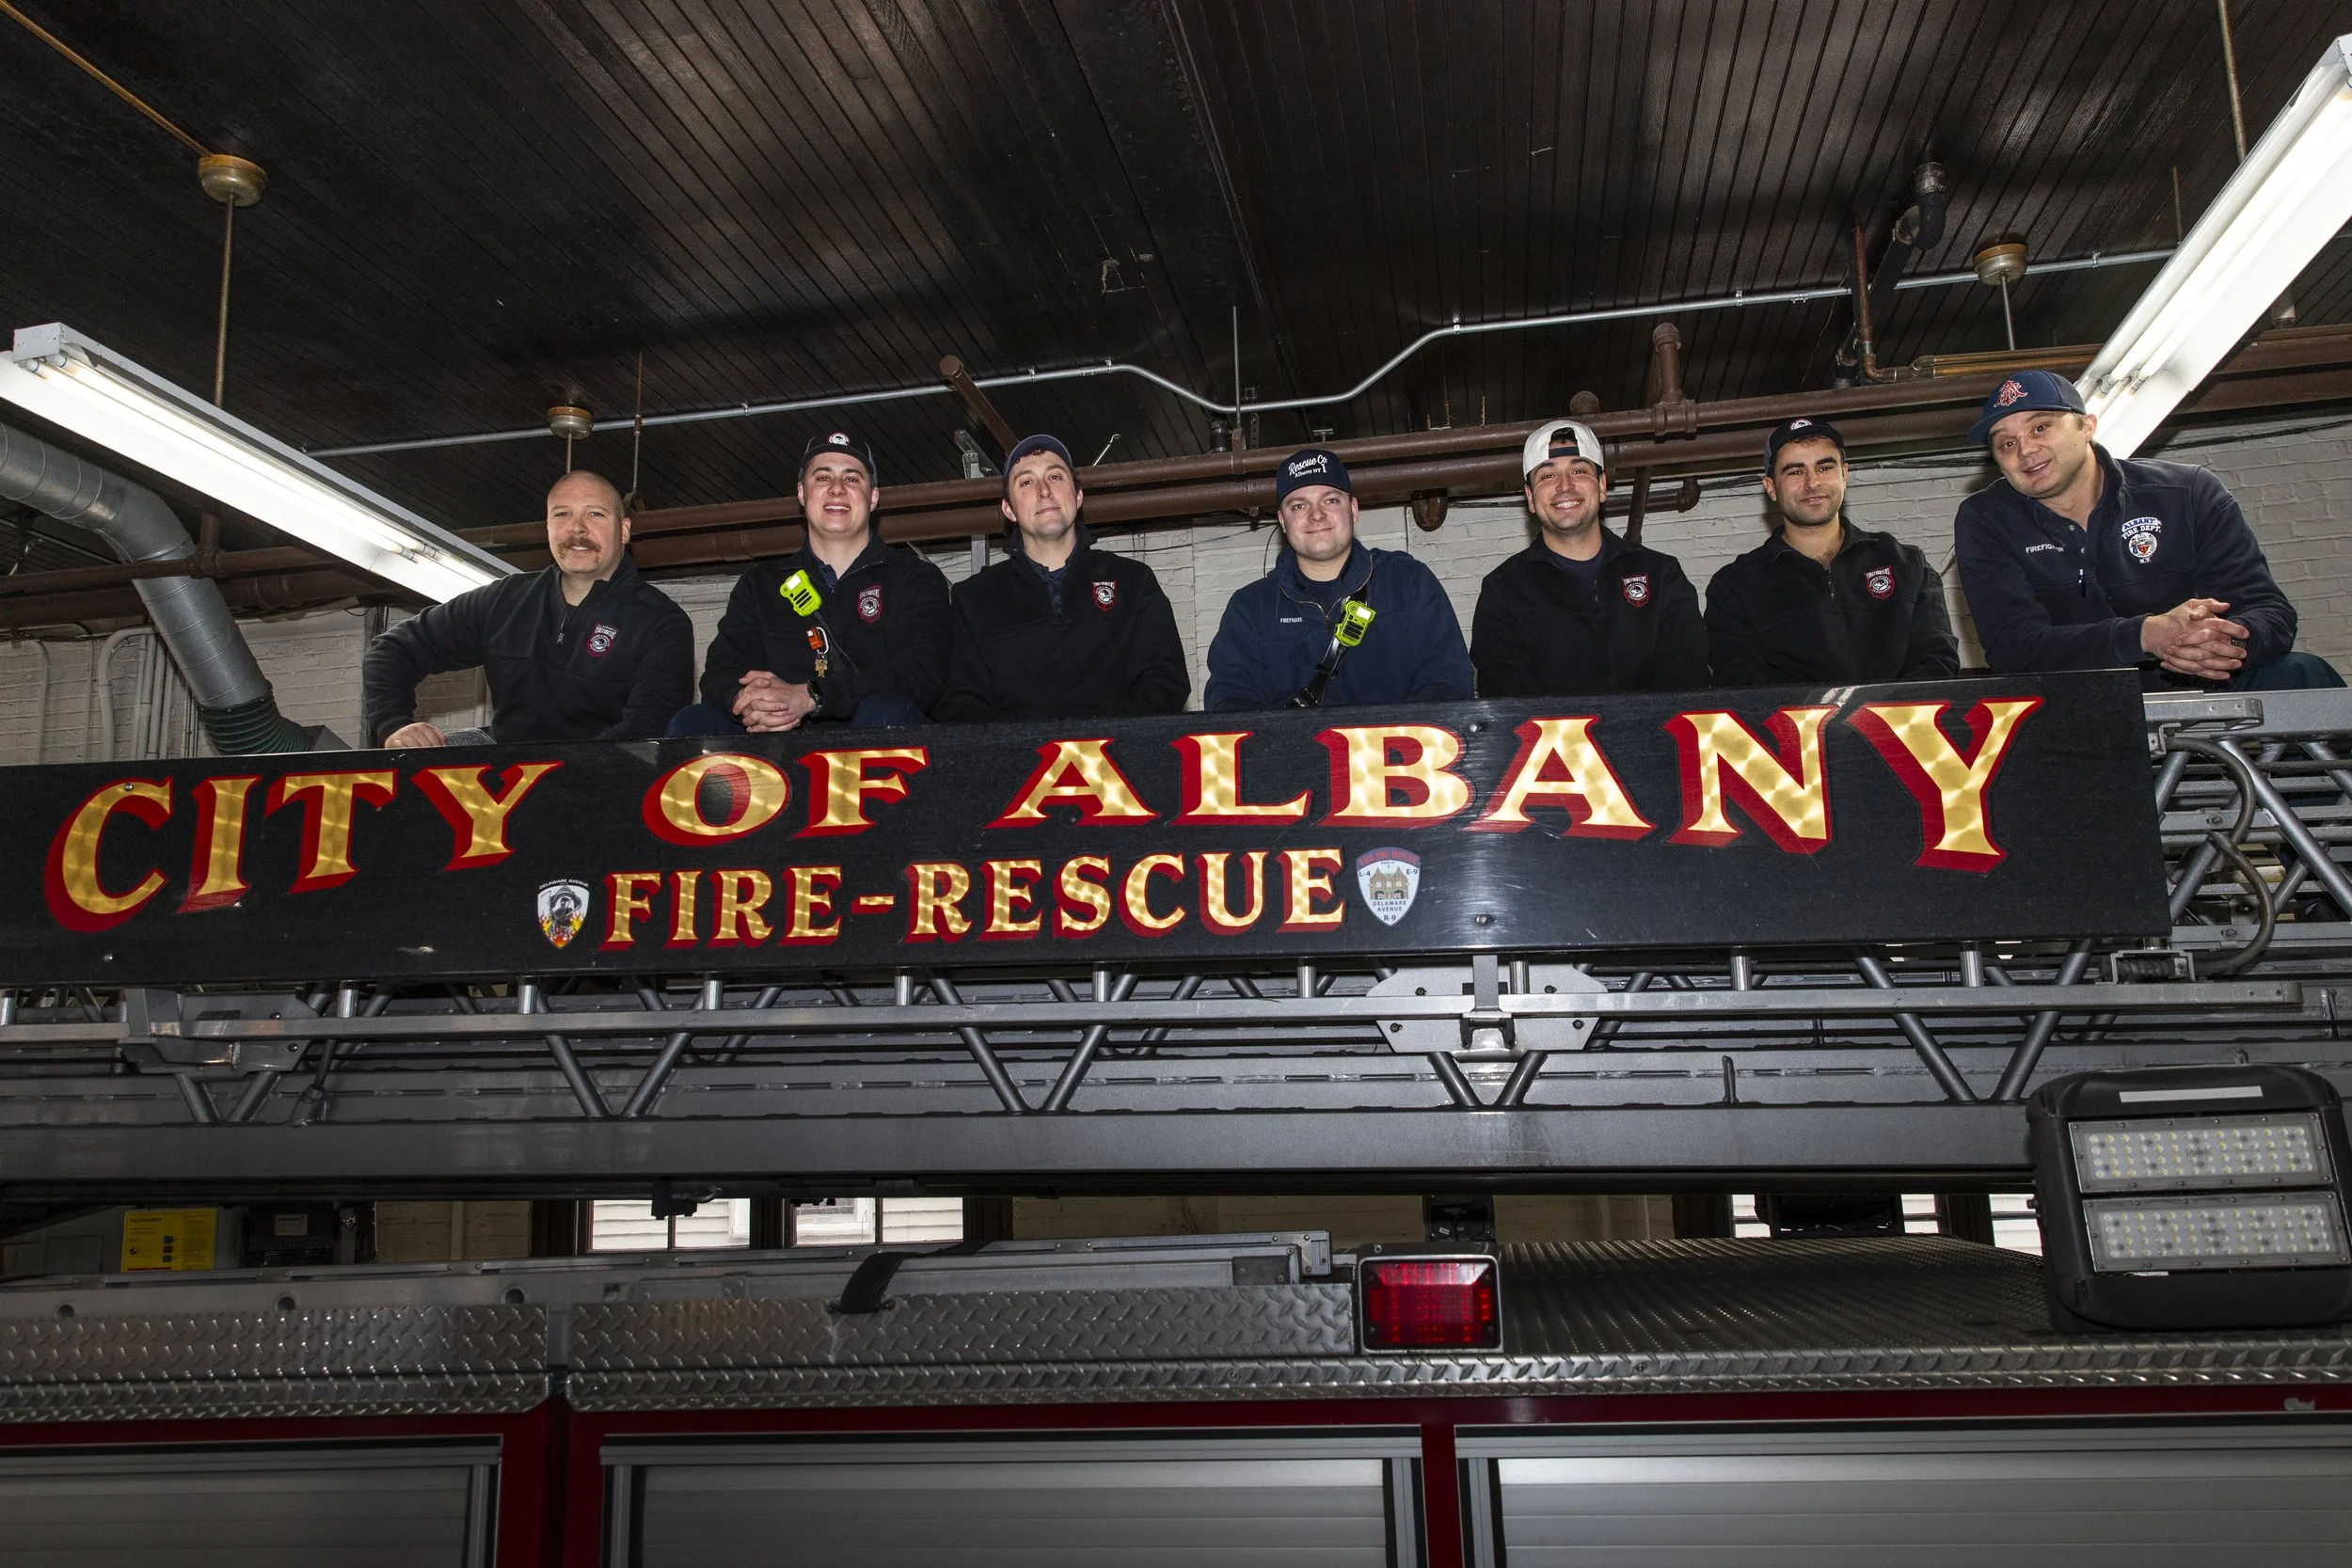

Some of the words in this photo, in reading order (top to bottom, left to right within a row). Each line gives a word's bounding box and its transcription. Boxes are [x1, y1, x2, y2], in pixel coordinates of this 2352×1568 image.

[1288, 457, 1317, 476] Rescue
[1295, 469, 1313, 478] Albany
[2123, 517, 2154, 530] ALBANY
[2121, 527, 2139, 540] FIRE
[2139, 525, 2161, 533] DEPT.
[45, 761, 564, 932] CITY
[642, 746, 930, 847] OF
[985, 695, 2044, 873] ALBANY
[539, 879, 566, 889] DELAWARE
[568, 879, 589, 887] AVENUE
[599, 848, 1344, 950] FIRE-RESCUE
